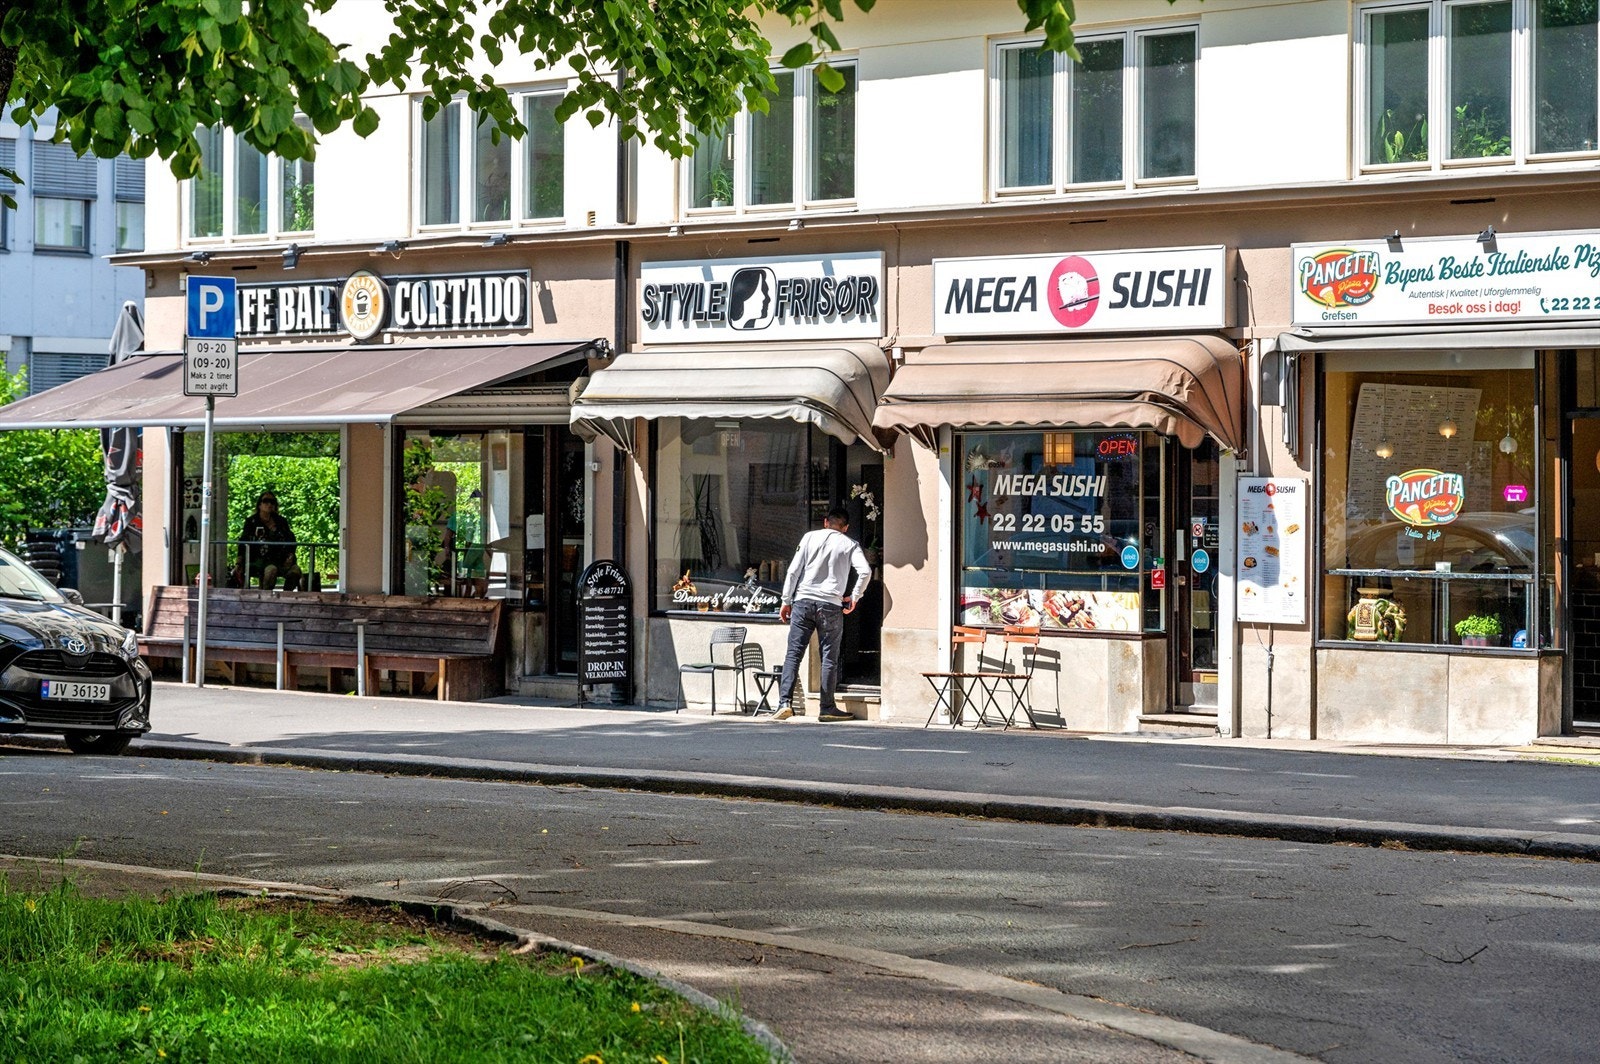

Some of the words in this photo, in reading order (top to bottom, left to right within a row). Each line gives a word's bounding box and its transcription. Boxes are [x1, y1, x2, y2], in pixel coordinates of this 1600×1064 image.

[1299, 251, 1381, 293] PANCETTA
[1385, 261, 1435, 292] Byens
[1439, 256, 1484, 280] Beste
[1486, 246, 1570, 276] Italienske
[945, 276, 1037, 314] MEGA
[1108, 268, 1212, 308] SUSHI
[1408, 289, 1444, 298] Autentisk
[1450, 288, 1478, 298] Kvalitet
[1484, 286, 1542, 298] Uforglemmelig
[278, 286, 330, 330] BAR
[395, 276, 520, 326] CORTADO
[642, 282, 727, 322] STYLE
[774, 276, 877, 318] FRISØR
[1552, 298, 1569, 310] 22
[1572, 297, 1590, 310] 22
[200, 285, 224, 330] P
[1428, 302, 1463, 314] Besøk
[1466, 304, 1486, 313] oss
[1488, 301, 1492, 312] i
[1495, 301, 1521, 314] dag!
[1322, 310, 1358, 320] Grefsen
[197, 343, 226, 353] 09-20
[194, 357, 230, 369] (09-20)
[190, 372, 206, 380] Maks
[210, 372, 214, 380] 2
[216, 372, 232, 380] timer
[210, 383, 228, 392] avgift
[1100, 440, 1136, 454] OPEN
[993, 474, 1047, 496] MEGA
[1050, 474, 1106, 497] SUSHI
[1247, 486, 1266, 494] MEGA
[1276, 486, 1296, 494] SUSHI
[1386, 472, 1464, 509] PANCETTA
[992, 513, 1016, 532] 22
[1022, 514, 1046, 532] 22
[1051, 514, 1074, 533] 05
[1080, 514, 1105, 534] 55
[992, 540, 1106, 554] www.megasushi.no
[587, 568, 604, 588] Style
[605, 566, 626, 585] Frisør
[587, 661, 624, 671] DROP-IN
[585, 670, 626, 678] VELKOMMEN!
[53, 683, 67, 696] JV
[72, 684, 106, 698] 36139
